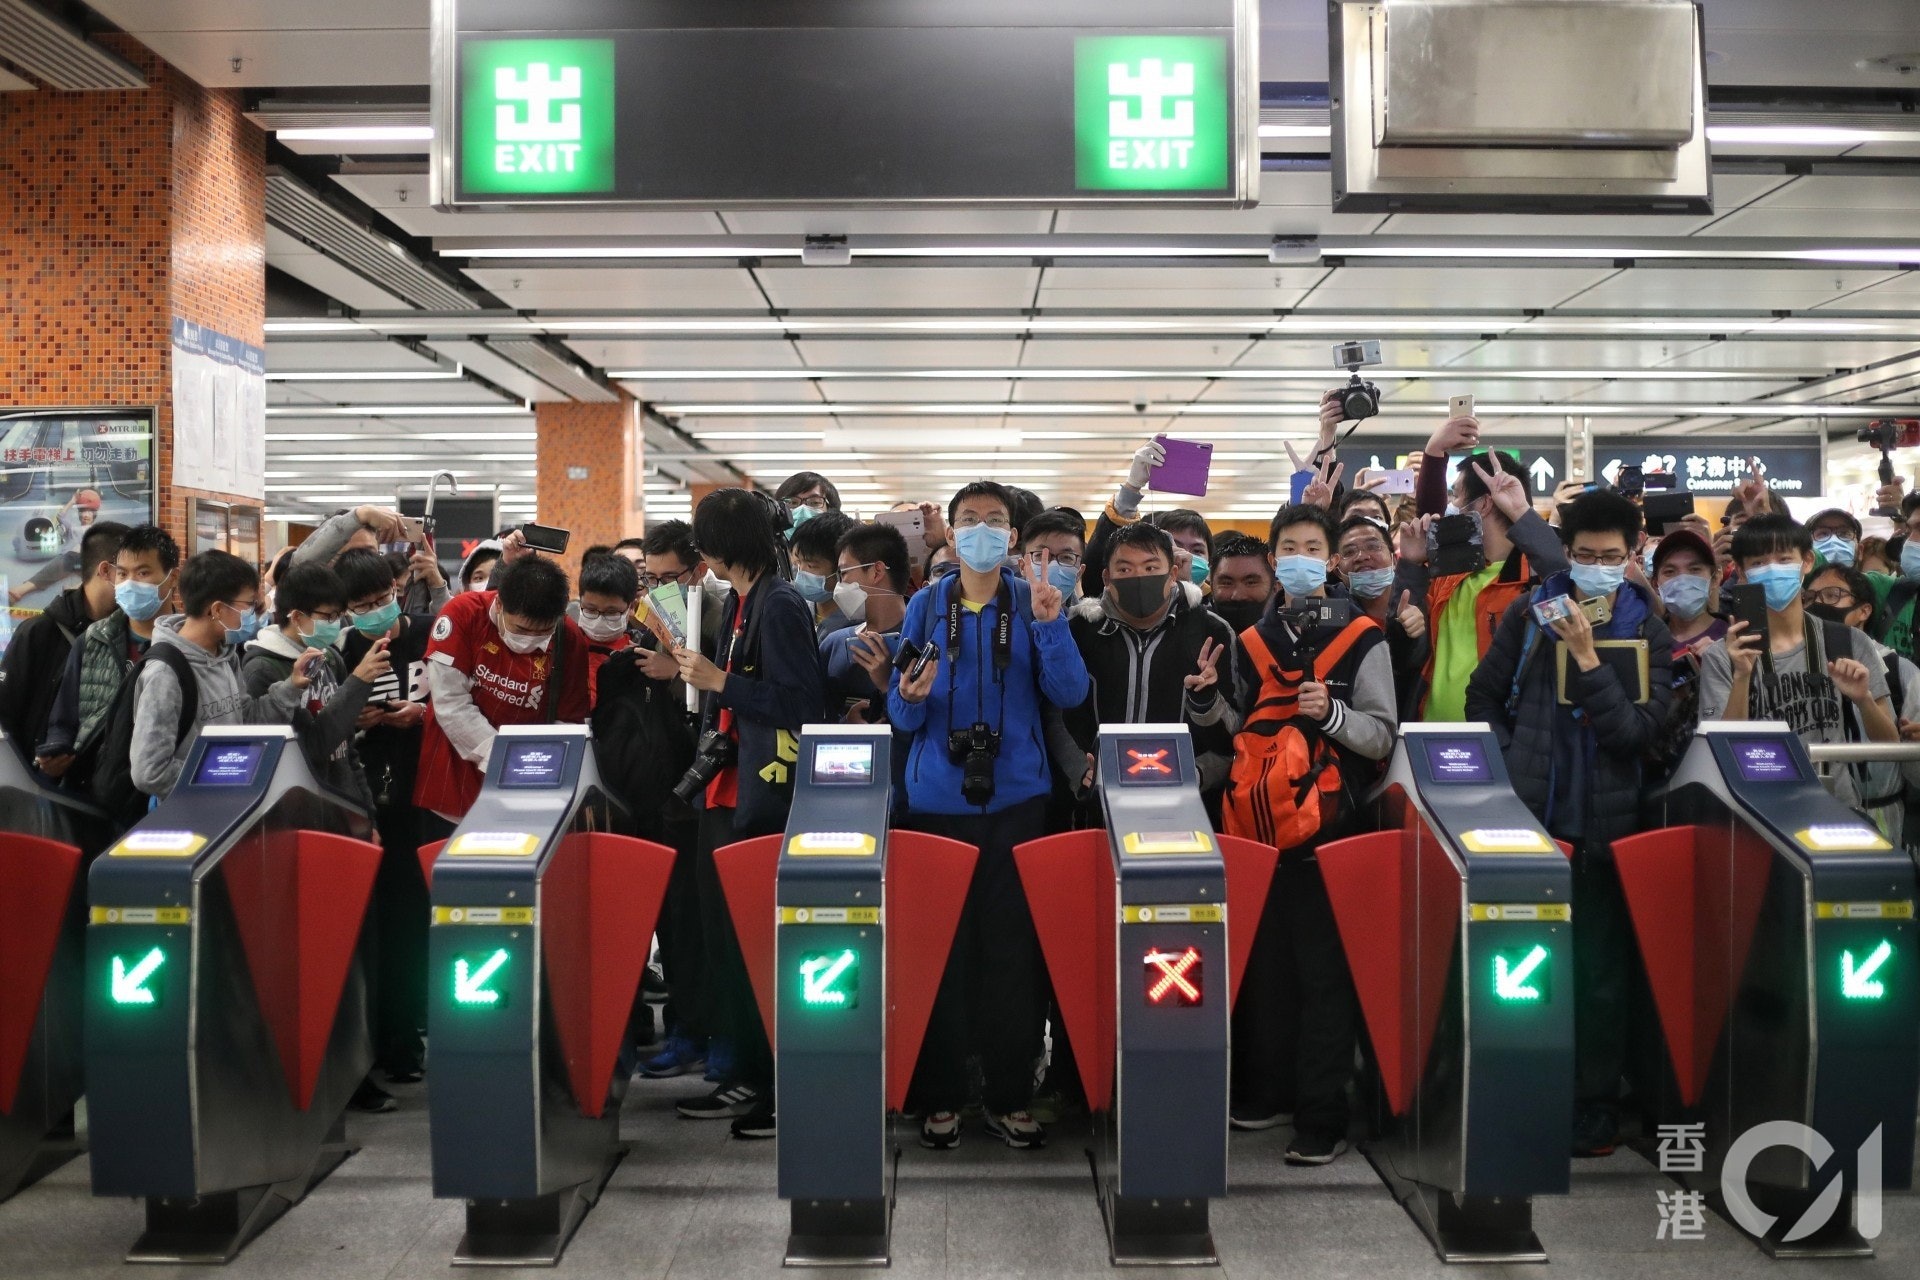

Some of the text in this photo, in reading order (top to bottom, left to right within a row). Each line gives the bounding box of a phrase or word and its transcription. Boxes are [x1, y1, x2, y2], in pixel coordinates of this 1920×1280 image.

[495, 62, 581, 140] 出
[1108, 58, 1194, 138] 出
[495, 143, 582, 174] EXIT
[1108, 139, 1195, 170] EXIT
[109, 424, 129, 433] MTR
[4, 447, 138, 462] 扶手電梯上 切勿走動
[1685, 455, 1767, 478] 客務中心
[1686, 478, 1734, 491] Customer
[1769, 478, 1802, 491] Centre
[1000, 613, 1009, 644] Canon
[475, 663, 529, 693] Standard
